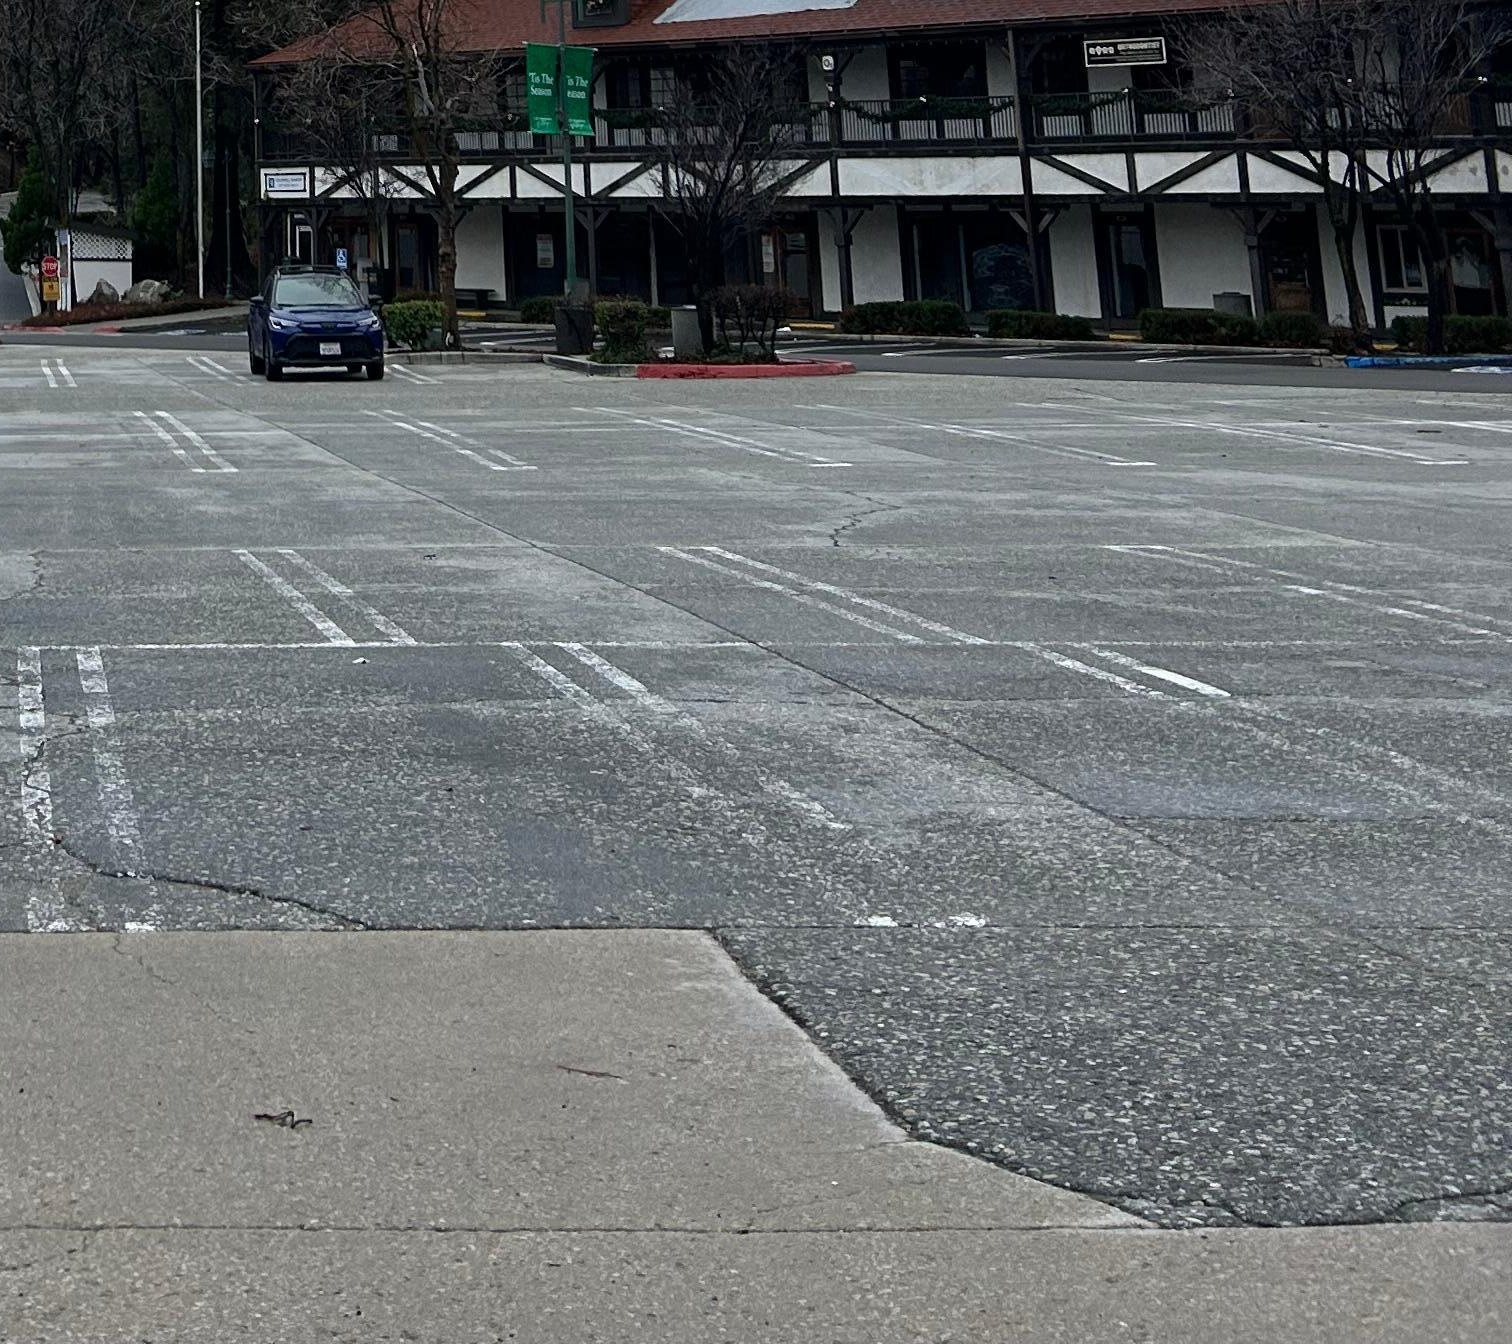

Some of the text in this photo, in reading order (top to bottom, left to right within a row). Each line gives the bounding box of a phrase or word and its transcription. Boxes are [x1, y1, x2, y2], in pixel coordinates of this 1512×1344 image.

[541, 73, 554, 85] The
[567, 90, 586, 99] eason
[42, 262, 58, 270] STOP
